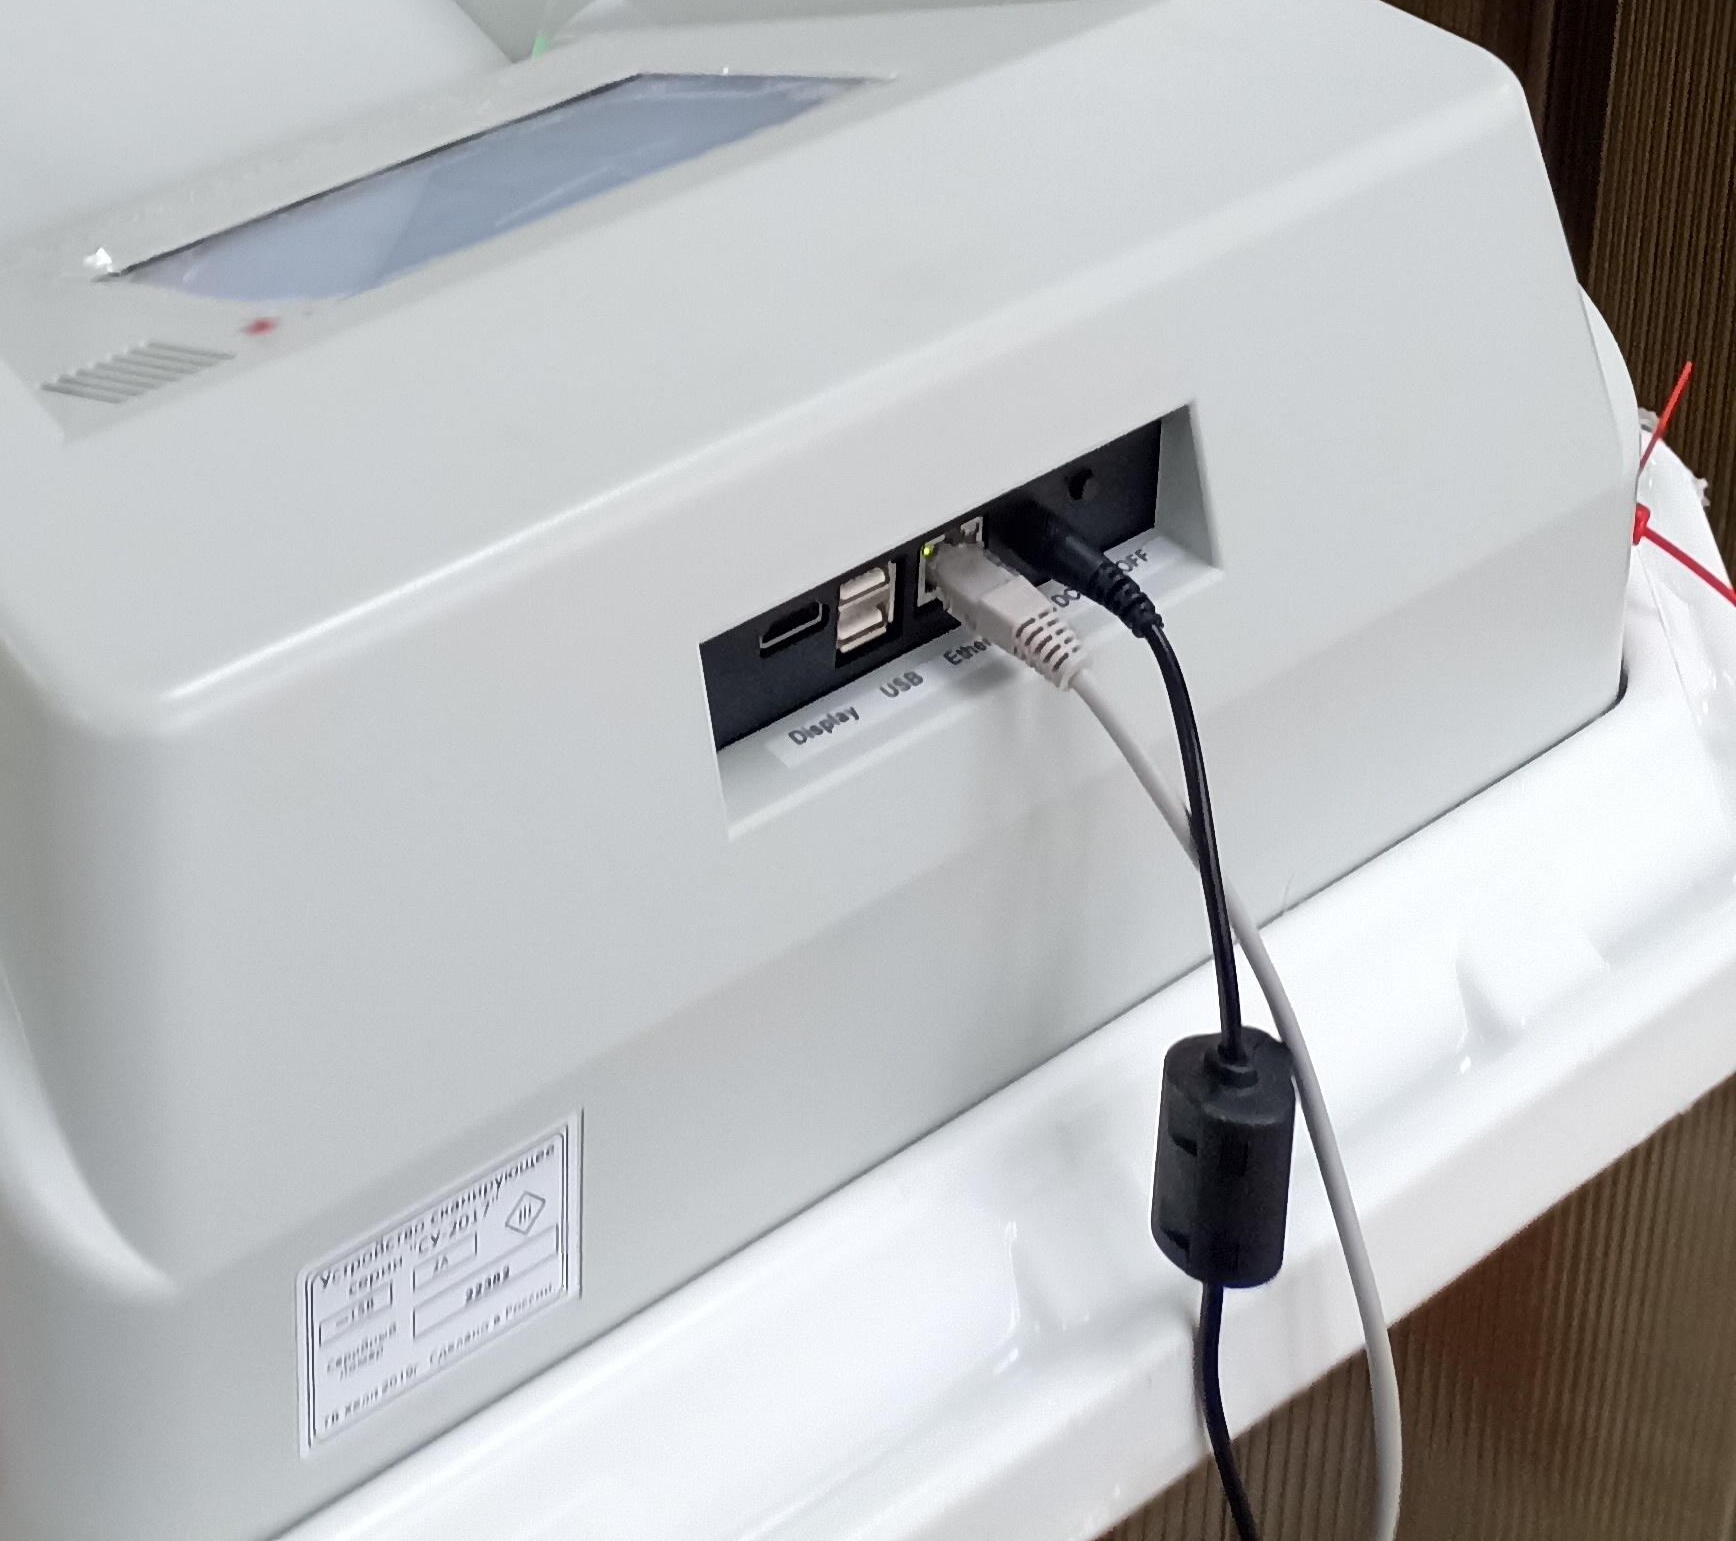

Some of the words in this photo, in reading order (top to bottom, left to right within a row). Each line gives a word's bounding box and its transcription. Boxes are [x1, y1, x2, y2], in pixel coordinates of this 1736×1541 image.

[880, 670, 924, 699] USB
[789, 705, 860, 745] Display
[319, 1219, 425, 1289] Устройство
[430, 1143, 555, 1224] сканирующее
[349, 1255, 403, 1296] серии
[429, 1320, 489, 1365] Сделано
